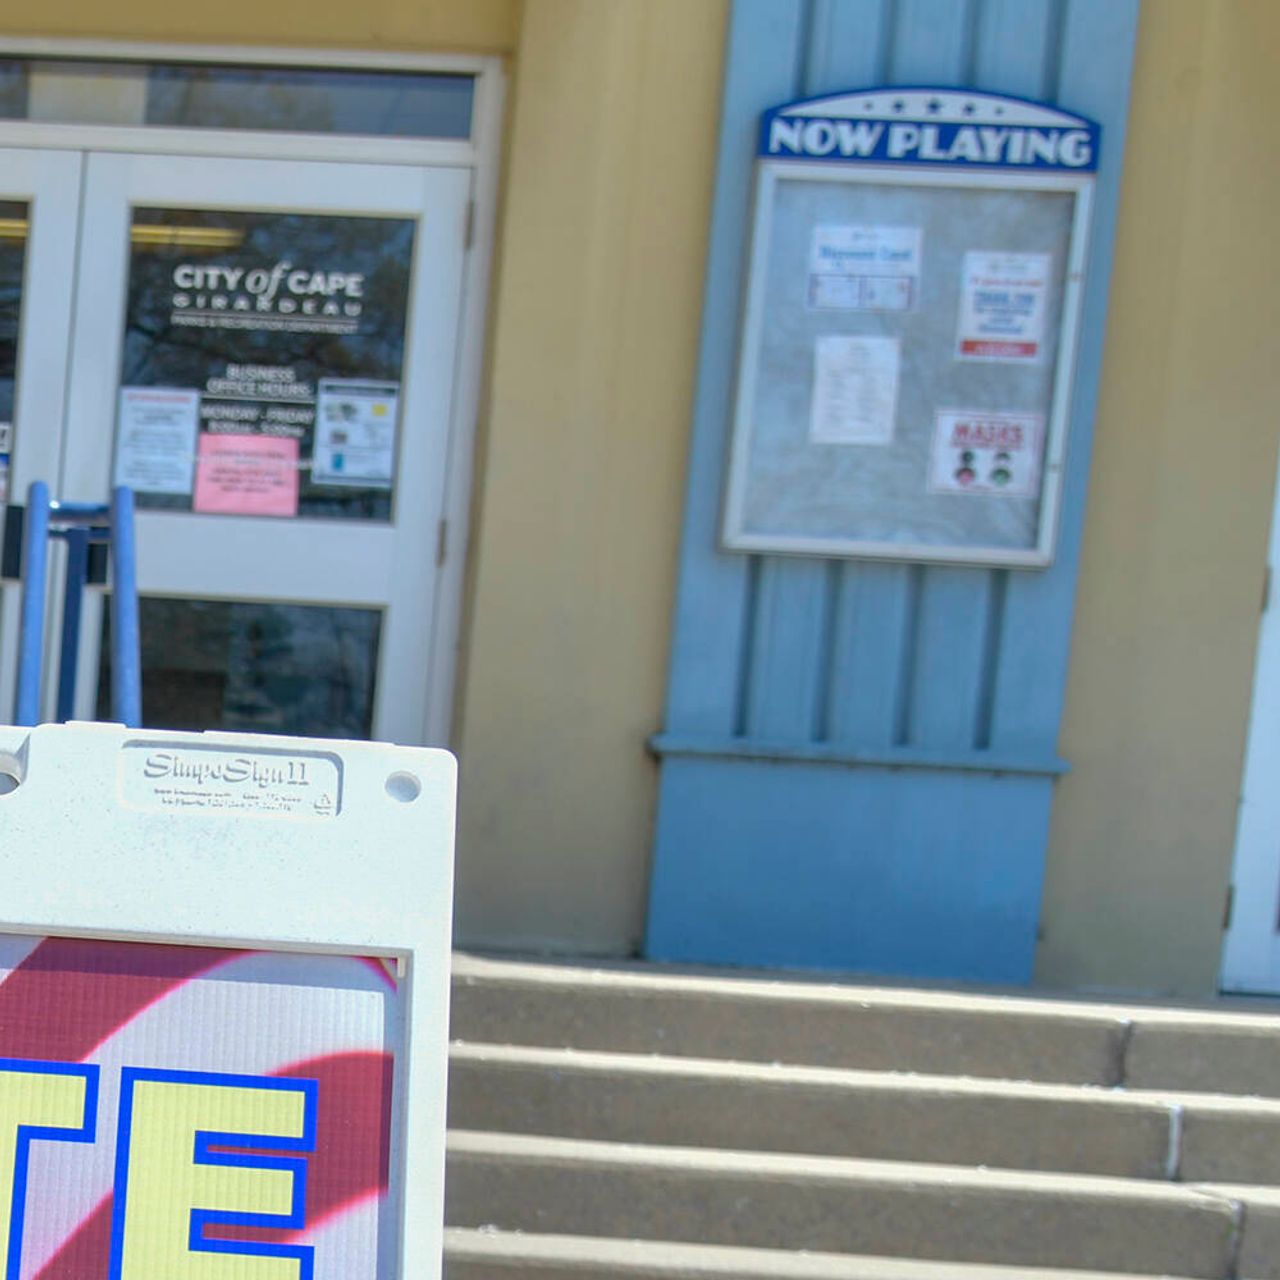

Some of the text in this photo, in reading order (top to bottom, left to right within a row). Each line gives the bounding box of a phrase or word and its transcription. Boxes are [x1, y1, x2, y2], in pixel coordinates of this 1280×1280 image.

[768, 118, 1091, 168] NOW PLAYING
[173, 260, 365, 301] CITY of CAPE
[172, 292, 363, 318] GIRARDEAU
[226, 363, 296, 383] BUSINESS
[206, 378, 257, 396] OFFICE
[200, 403, 260, 421] MONDAY
[266, 407, 314, 424] FRIDAY
[954, 422, 1024, 444] MASKS
